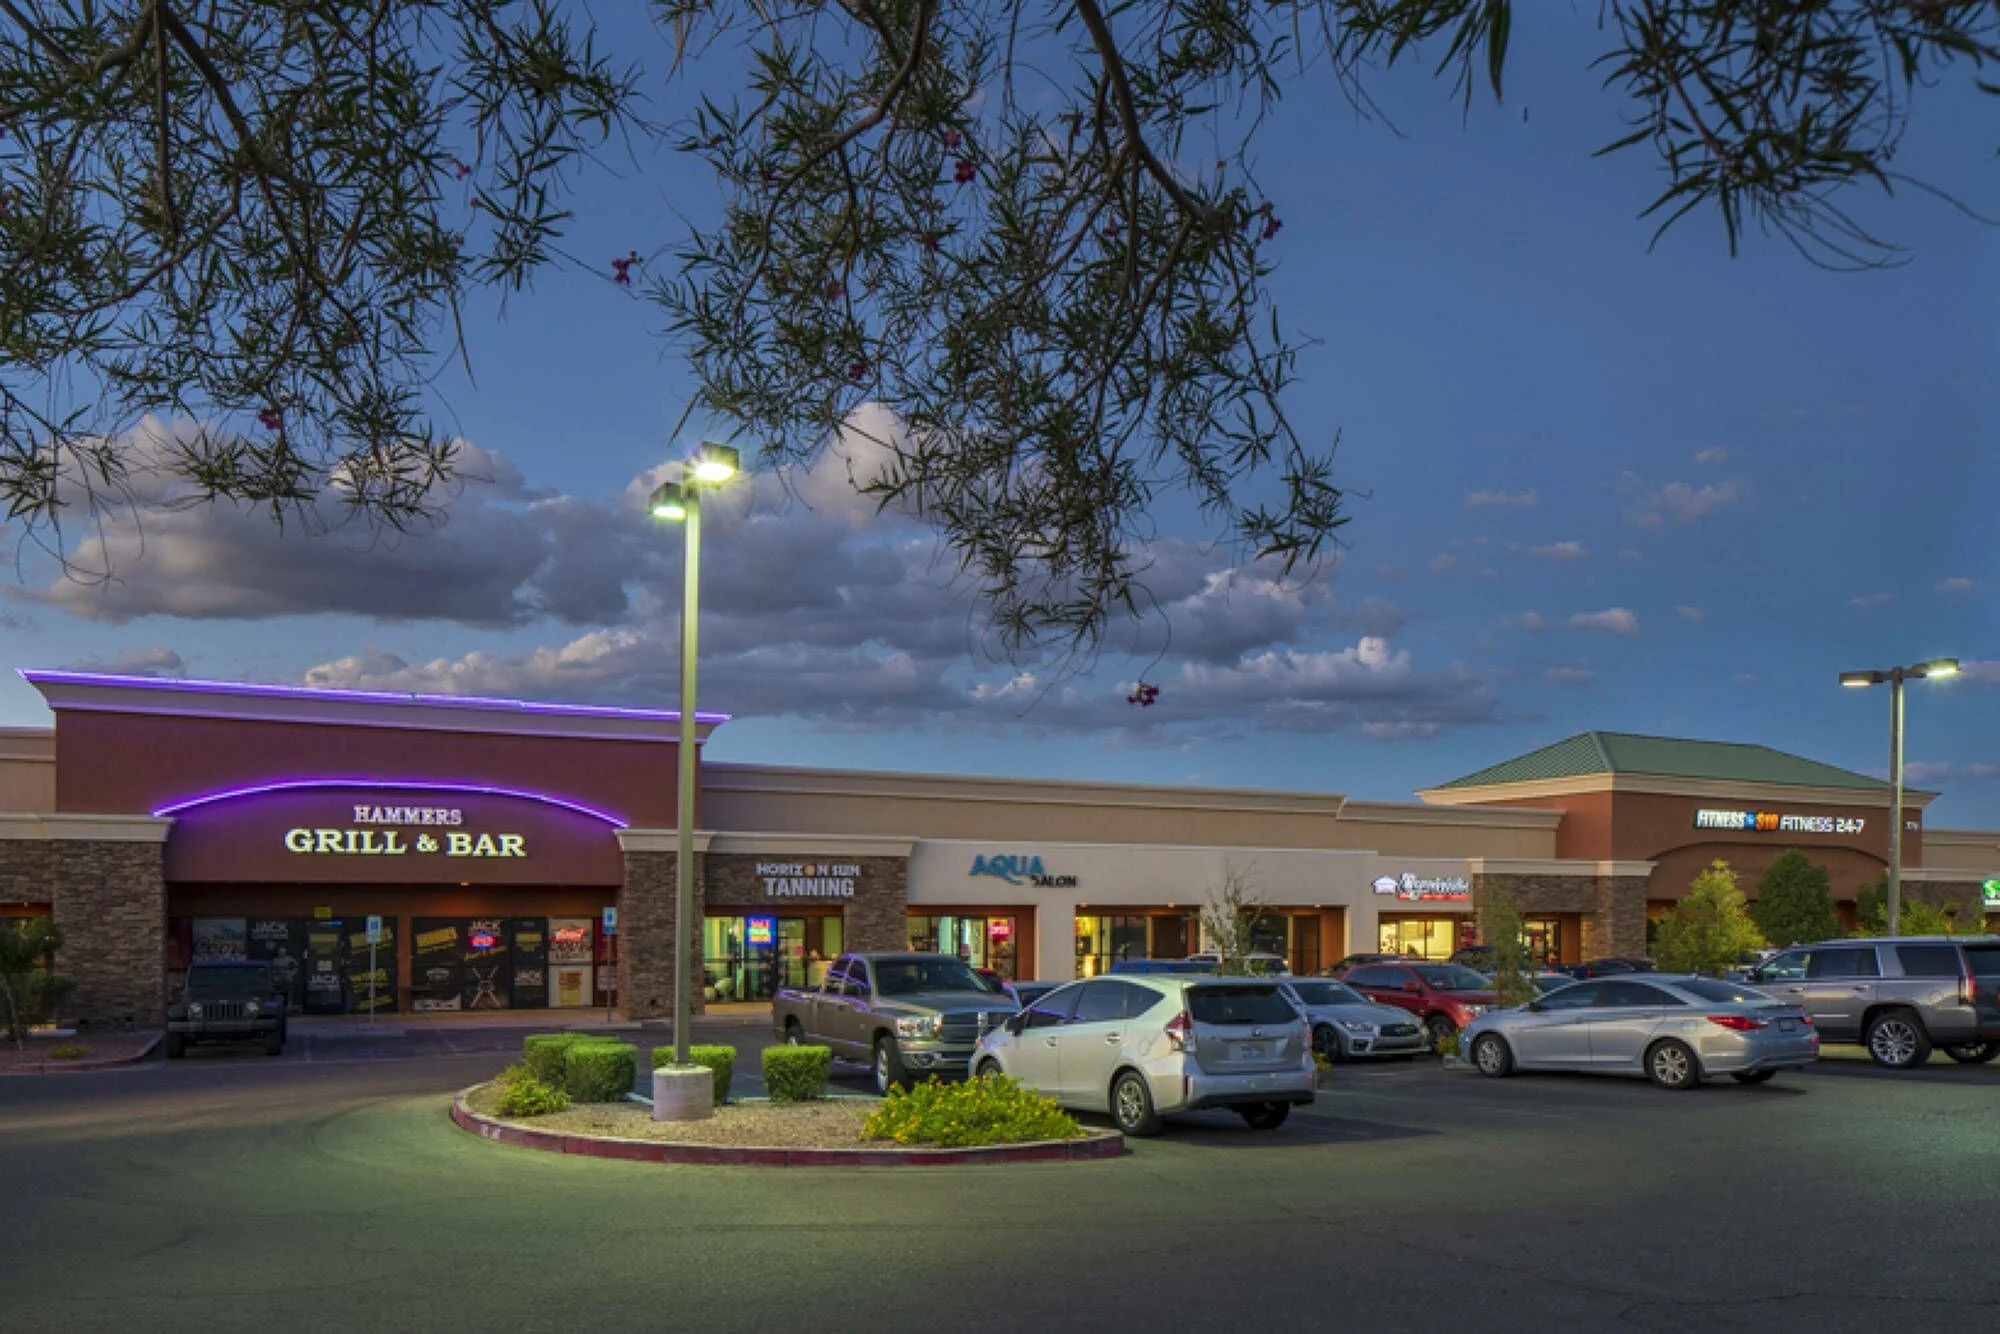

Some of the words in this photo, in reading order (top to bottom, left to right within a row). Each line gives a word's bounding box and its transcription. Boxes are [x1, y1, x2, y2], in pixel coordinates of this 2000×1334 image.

[353, 804, 463, 825] HAMMERS
[1697, 809, 1746, 828] FITNESS
[1780, 815, 1832, 832] FITNESS
[284, 828, 408, 855] GRILL
[416, 832, 440, 853] &
[446, 832, 528, 857] BAR
[968, 854, 1045, 885] AQUA
[762, 877, 855, 897] TANNING
[1030, 874, 1077, 888] SALON
